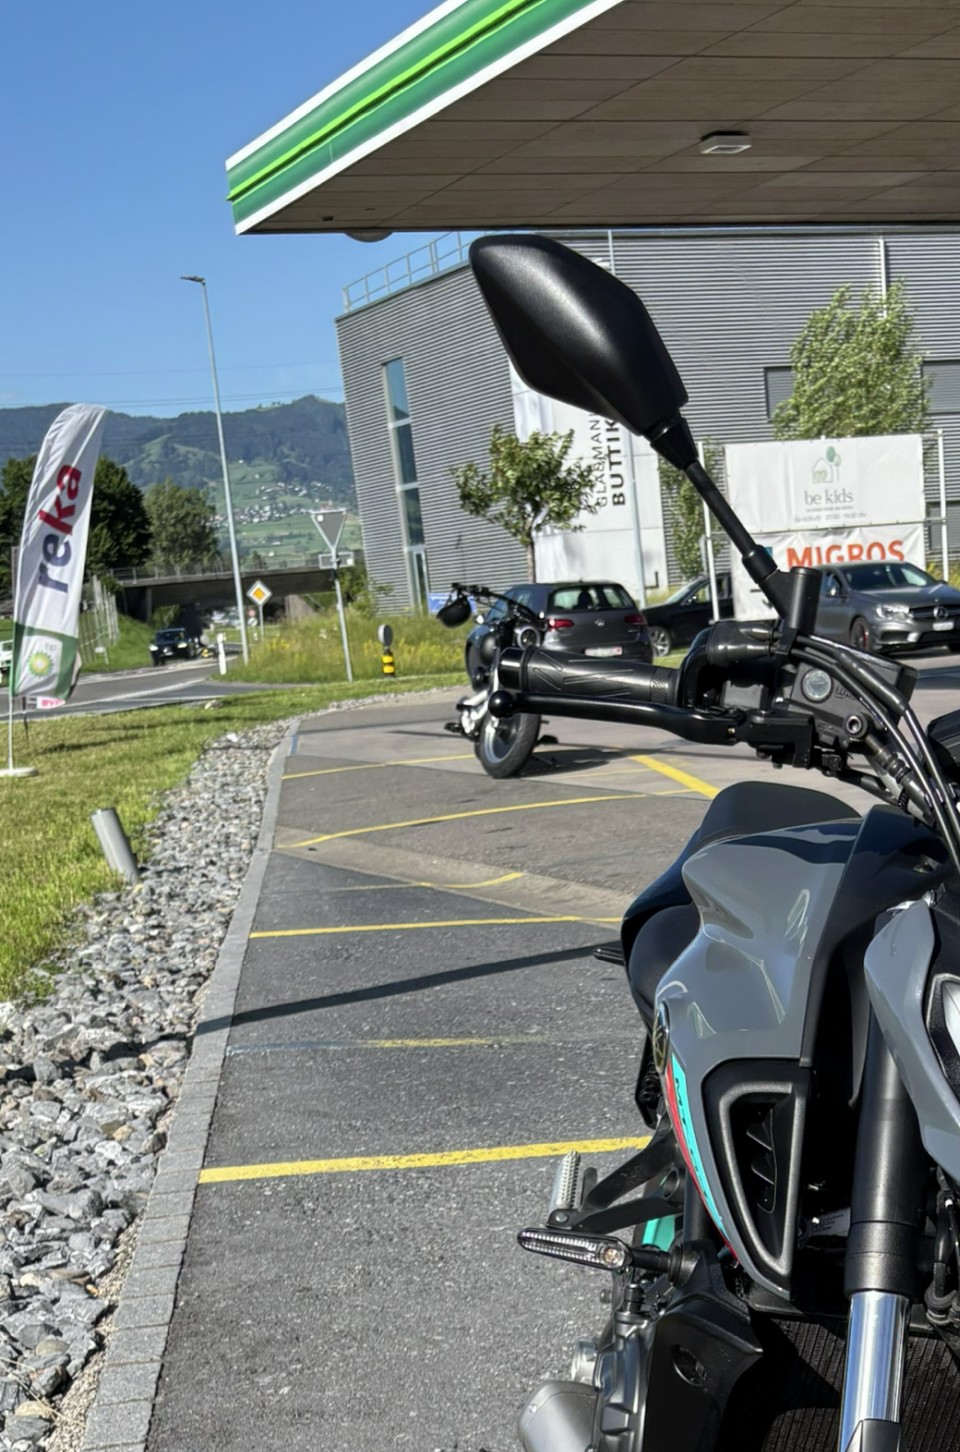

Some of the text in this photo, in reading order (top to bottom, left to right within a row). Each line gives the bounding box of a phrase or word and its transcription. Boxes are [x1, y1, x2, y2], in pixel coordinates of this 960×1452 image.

[803, 488, 854, 506] be kids
[38, 464, 82, 594] reka
[786, 540, 905, 568] MIGROS
